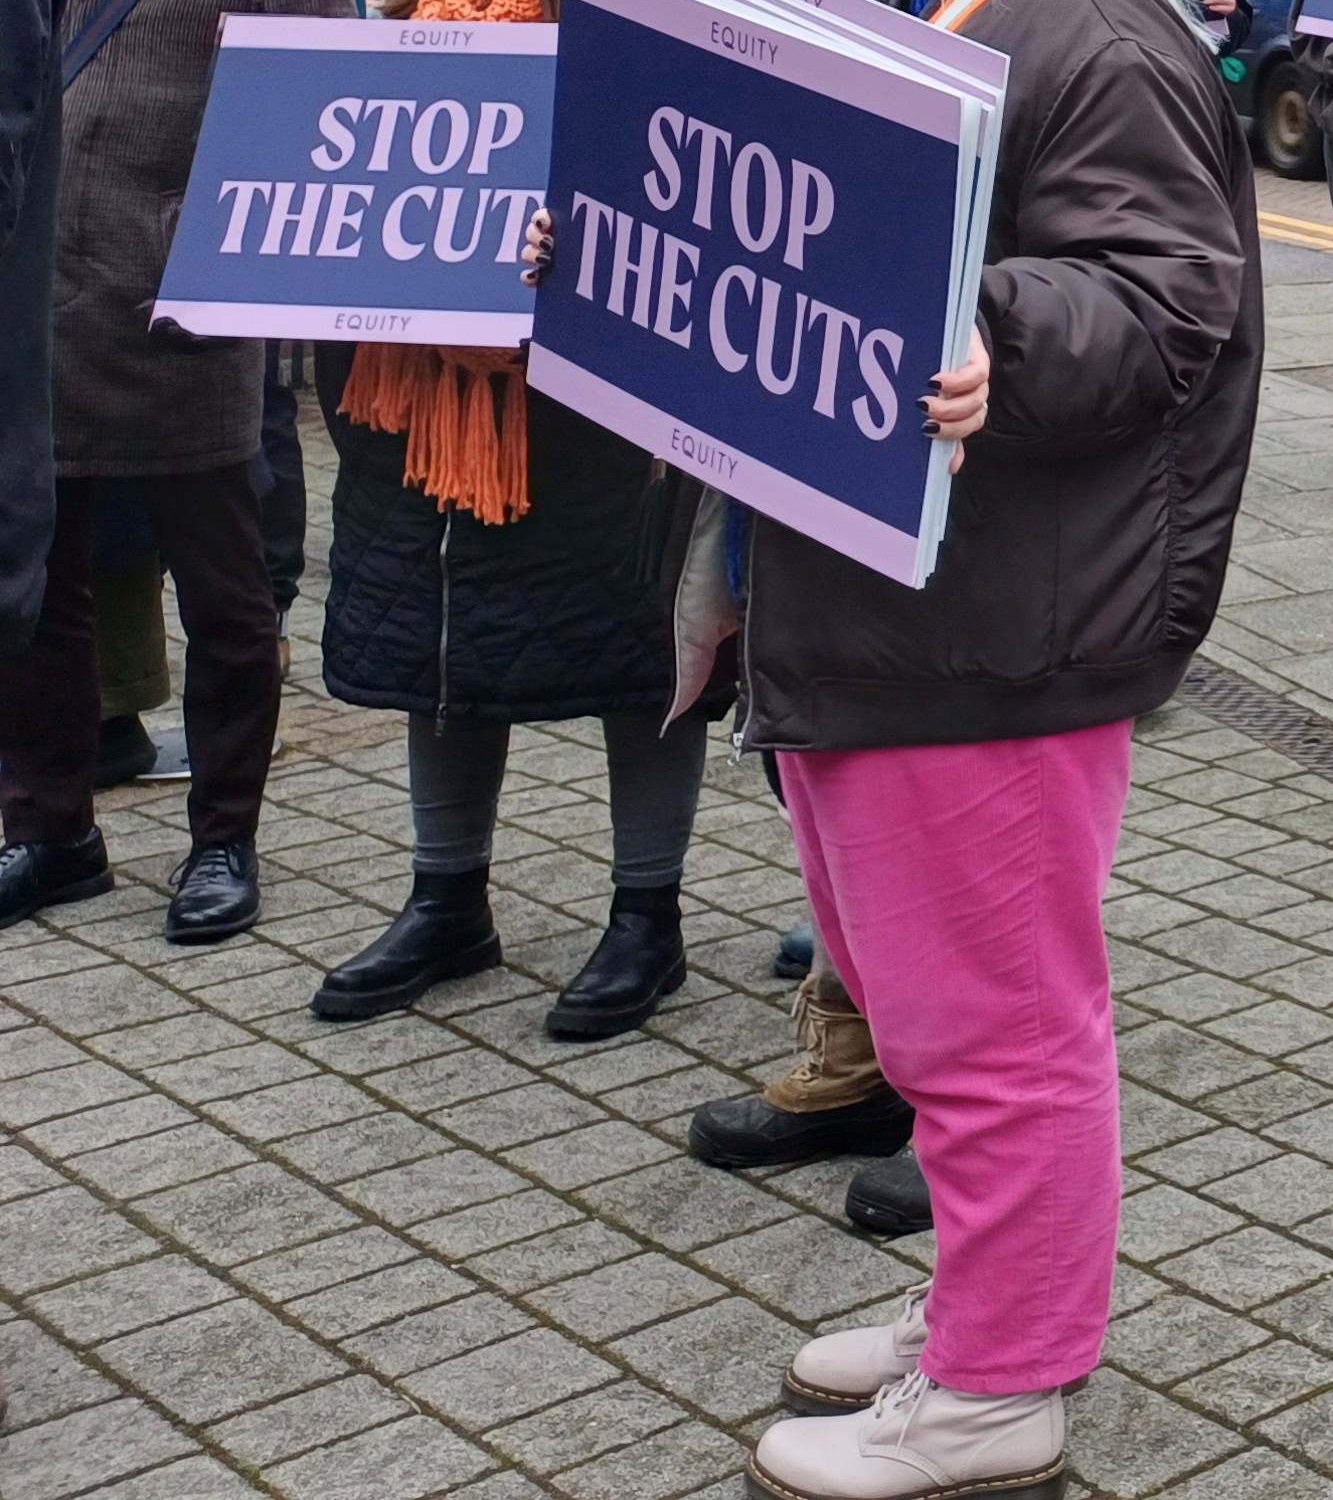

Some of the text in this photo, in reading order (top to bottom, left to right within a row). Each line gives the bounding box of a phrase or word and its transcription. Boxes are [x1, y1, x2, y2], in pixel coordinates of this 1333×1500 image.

[399, 29, 474, 47] EQUITY
[711, 21, 778, 65] EQUITY
[311, 97, 524, 175] STOP
[643, 106, 835, 271] STOP
[217, 180, 547, 265] THE CUT
[334, 313, 412, 332] EQUITY
[571, 190, 904, 441] THE CUTS
[671, 427, 739, 479] EQUITY
